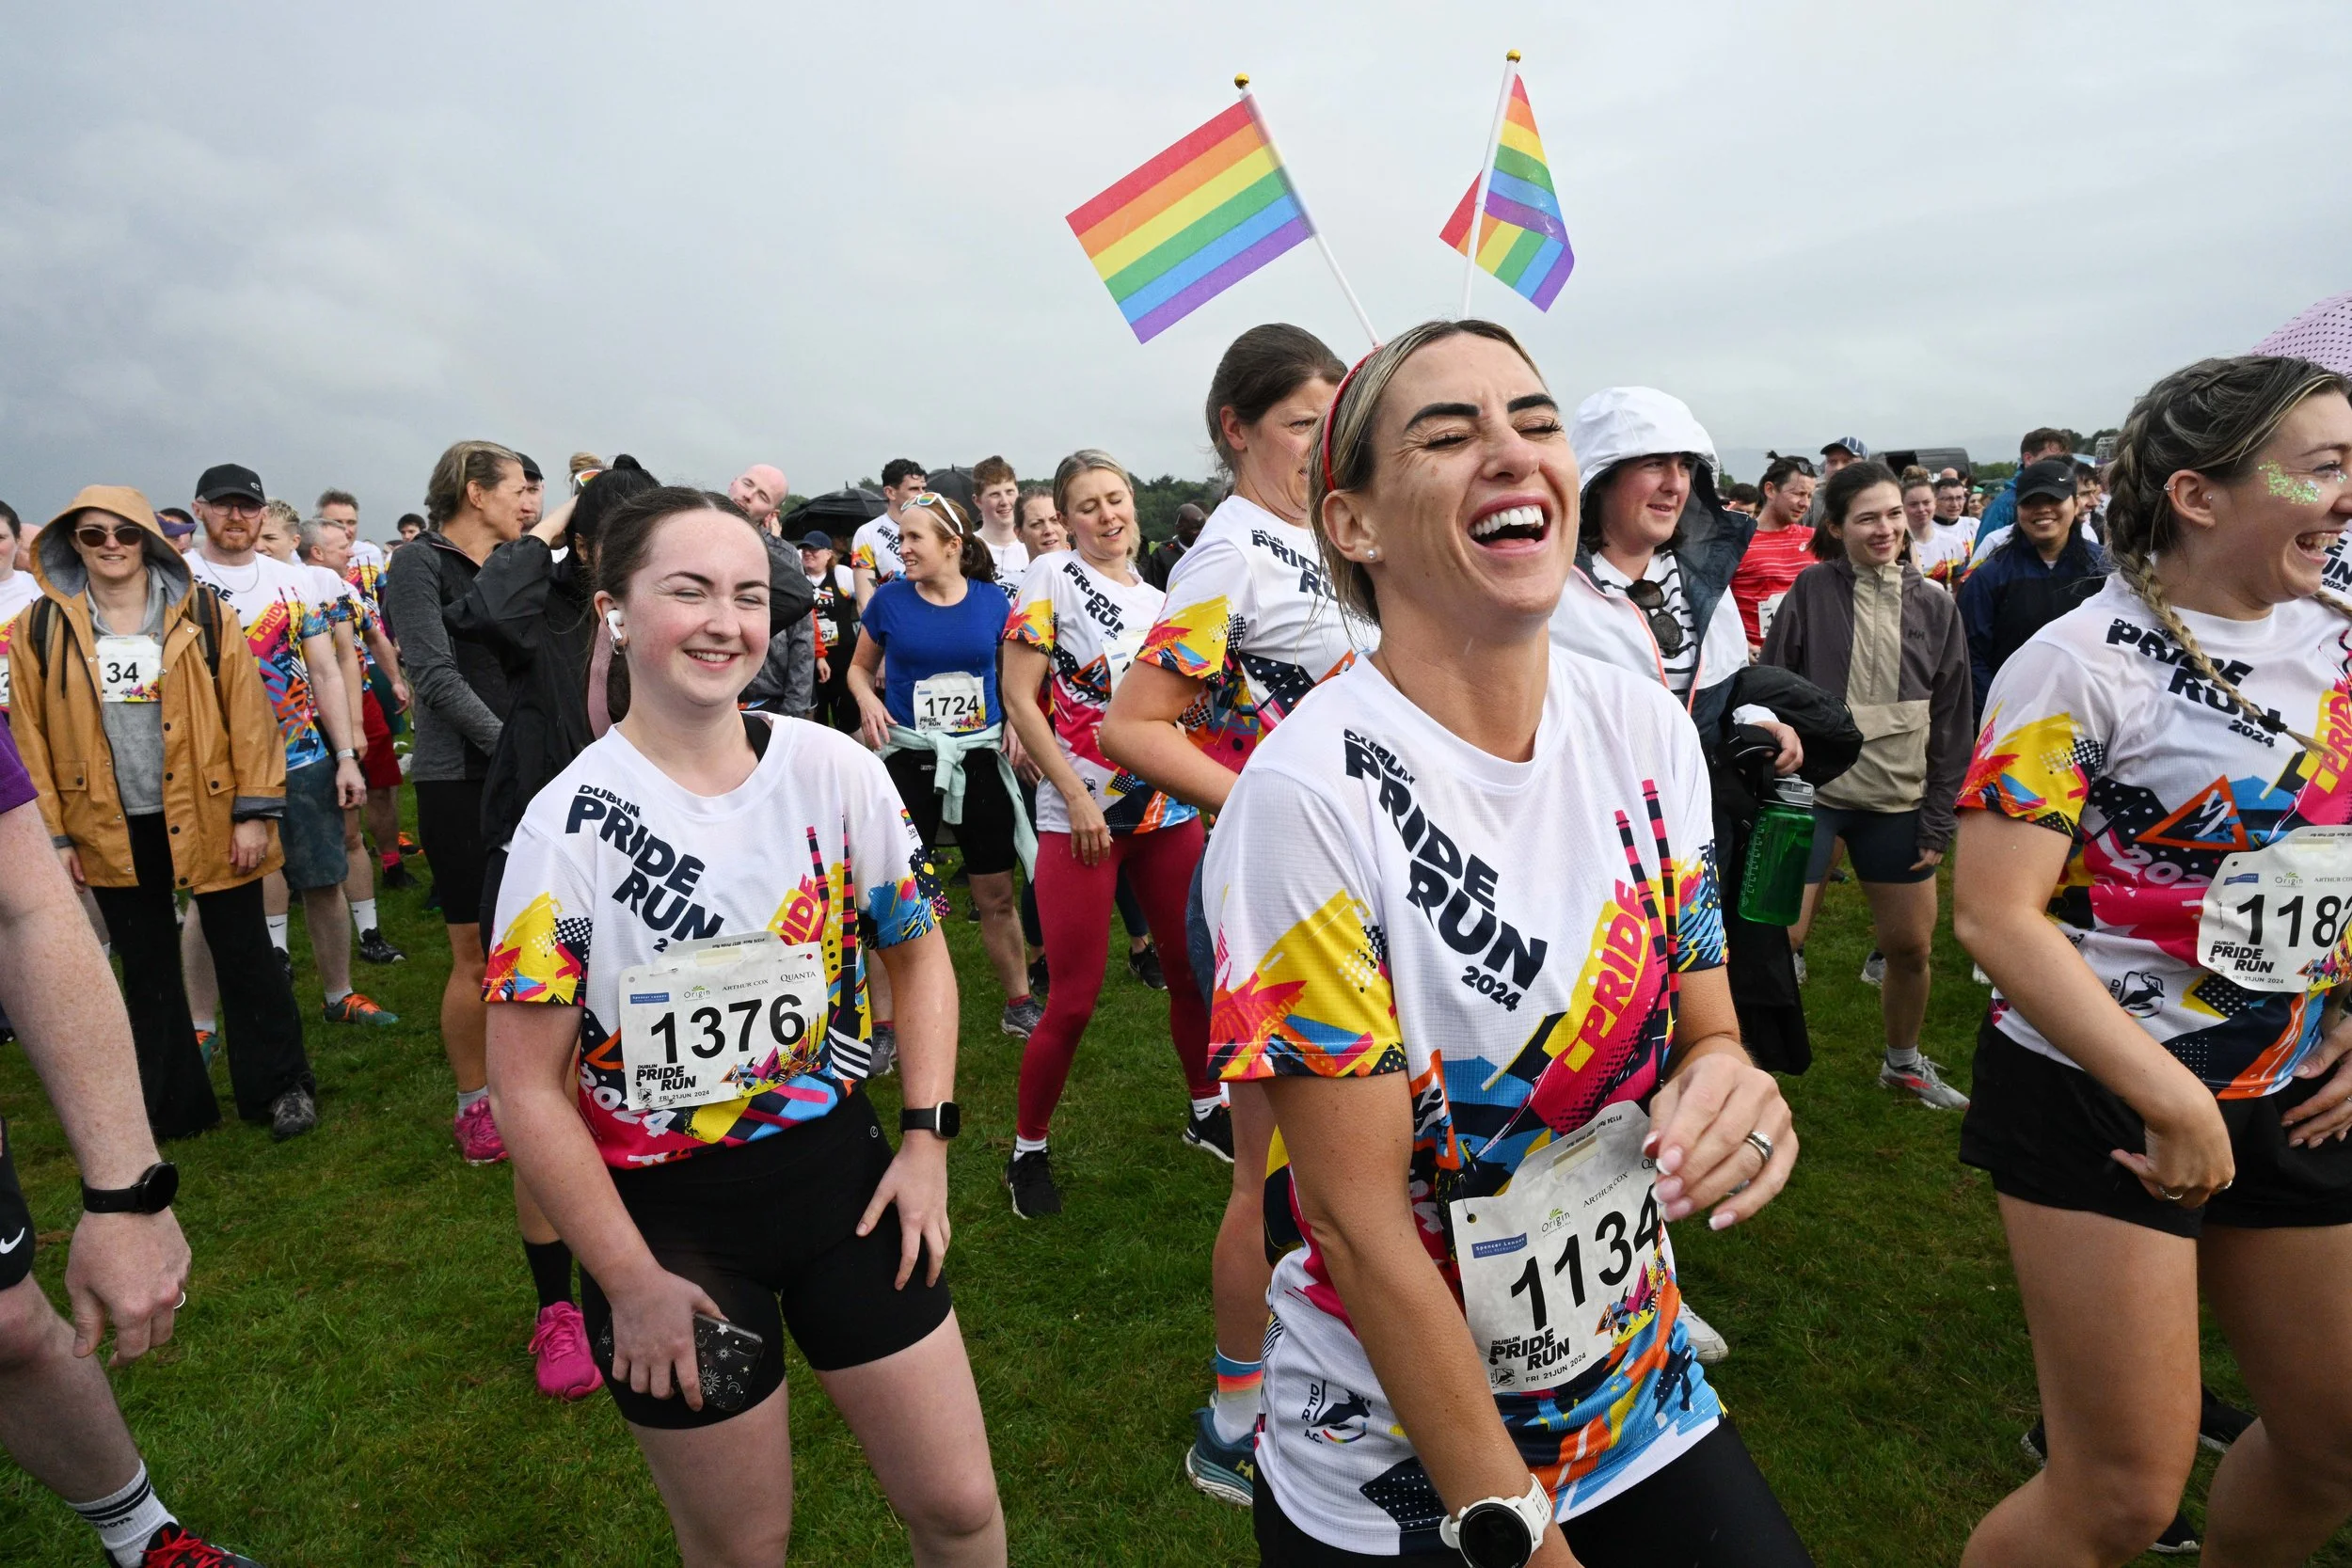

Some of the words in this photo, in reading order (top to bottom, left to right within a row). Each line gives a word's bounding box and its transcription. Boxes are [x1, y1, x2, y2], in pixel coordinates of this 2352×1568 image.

[877, 528, 900, 545] PRID
[886, 543, 902, 556] RU
[1252, 532, 1324, 577] PRID
[1299, 569, 1339, 602] RU
[2322, 557, 2352, 585] UN
[2322, 578, 2347, 593] 2024
[1062, 562, 1122, 618] PRIDE
[256, 600, 285, 637] PRIDE
[2106, 625, 2254, 687] PRIDE
[106, 661, 139, 684] 34
[925, 695, 979, 717] 1724
[2228, 720, 2275, 749] 2024
[1343, 728, 1415, 784] DUBLIN
[578, 784, 641, 818] DUBLIN
[1345, 739, 1499, 912] PRIDE
[565, 795, 706, 897] PRIDE
[2110, 848, 2213, 889] 202
[2275, 876, 2303, 885] Origin
[612, 867, 724, 942] RUN
[1406, 859, 1548, 990] RUN
[1579, 879, 1645, 1050] PRIDE
[2210, 945, 2264, 959] PRIDE
[2234, 959, 2274, 974] RUN
[723, 982, 752, 990] ARTHUR
[780, 971, 817, 983] QUANTA
[1461, 966, 1522, 1012] 2024
[684, 990, 710, 998] Origin
[651, 994, 804, 1064] 1376
[636, 1066, 685, 1081] PRIDE
[660, 1075, 696, 1091] RUN
[1583, 1183, 1613, 1208] ARTHUR
[1613, 1171, 1629, 1186] COX
[1541, 1212, 1570, 1232] Origin
[1475, 1242, 1502, 1252] Spencer
[1511, 1181, 1660, 1331] 1134
[1489, 1327, 1555, 1359] PRIDE
[1492, 1336, 1520, 1345] DUBLIN
[1527, 1338, 1569, 1370] RUN
[1543, 1364, 1567, 1380] 21JUN
[1570, 1352, 1586, 1368] 2024
[1302, 1383, 1320, 1421] DFR
